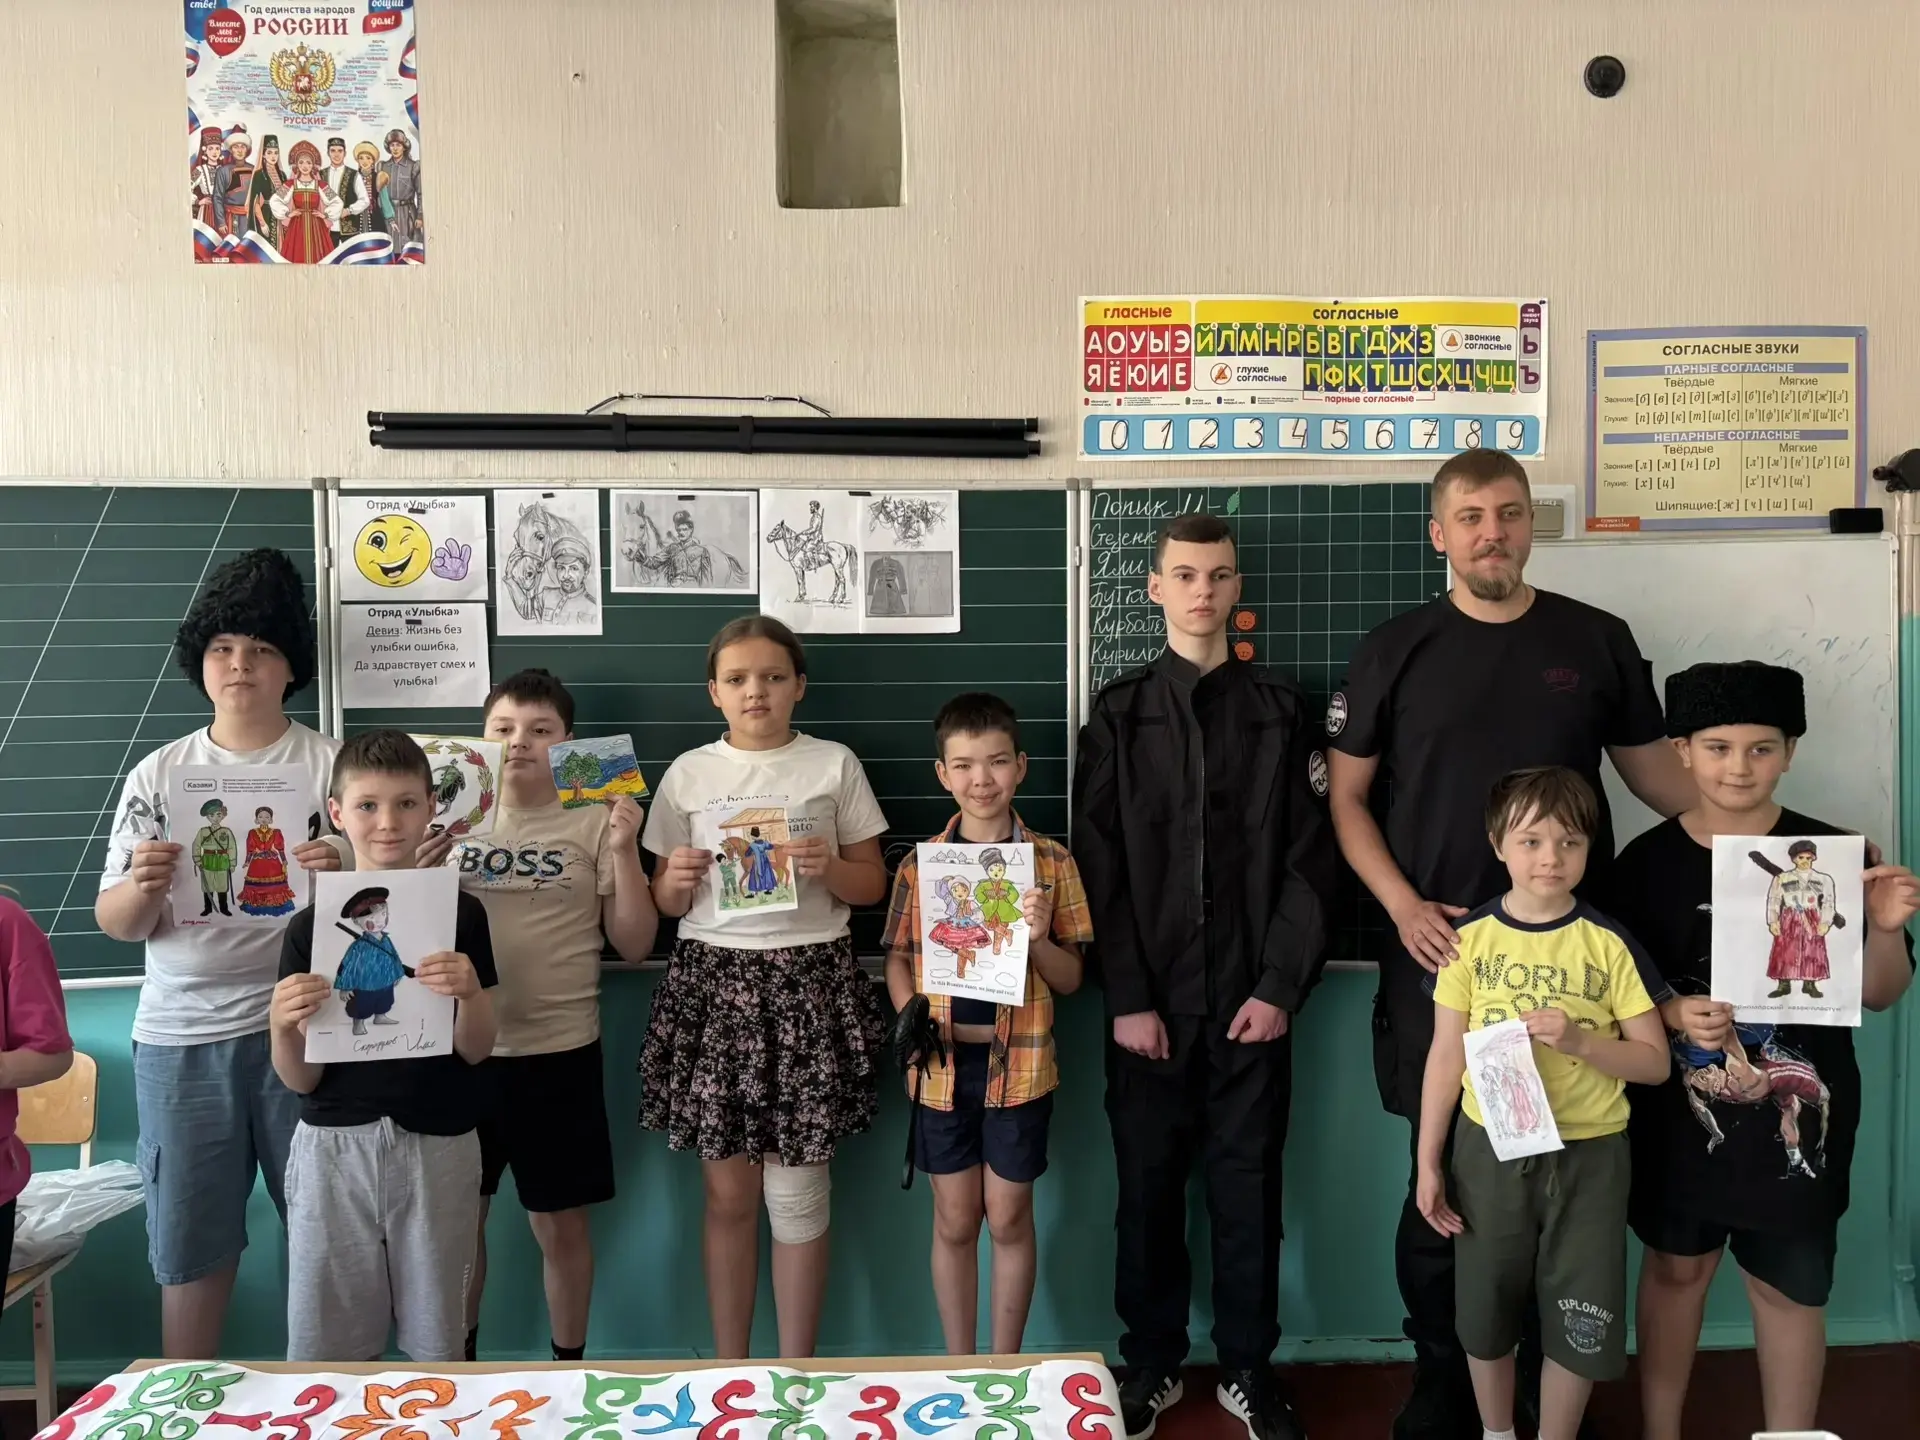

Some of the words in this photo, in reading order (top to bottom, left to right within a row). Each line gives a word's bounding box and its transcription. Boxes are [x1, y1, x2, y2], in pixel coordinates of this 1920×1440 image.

[244, 5, 262, 14] Год
[266, 6, 311, 14] единства
[314, 7, 355, 15] народов
[252, 18, 348, 35] РОССИИ
[370, 16, 395, 28] дом!
[208, 34, 242, 43] Россия!
[284, 116, 326, 125] РУССКИЕ
[1104, 306, 1172, 318] гласные
[1313, 306, 1399, 320] согласные
[1464, 334, 1500, 342] звонкие
[1464, 342, 1512, 351] согласные
[1663, 344, 1752, 356] СОГЛАСНЫЕ
[1755, 344, 1799, 354] ЗВУКИ
[1236, 365, 1269, 375] глухие
[1664, 364, 1718, 375] ПАРНЫЕ
[1721, 364, 1794, 373] СОГЛАСНЫЕ
[1236, 374, 1287, 383] согласные
[1664, 378, 1715, 388] Твёрдые
[1779, 376, 1818, 386] Мягкие
[1324, 395, 1361, 405] парные
[1363, 394, 1414, 403] согласные
[1111, 420, 1129, 450] 0
[1161, 420, 1173, 450] 1
[1199, 418, 1218, 449] 2
[1247, 418, 1264, 448] 3
[1292, 418, 1307, 448] 4
[1331, 419, 1348, 449] 5
[1376, 419, 1395, 449] 6
[1422, 418, 1439, 449] 7
[1465, 420, 1482, 448] 8
[1507, 421, 1524, 449] 9
[1654, 432, 1724, 442] НЕПАРНЫЕ
[1728, 431, 1800, 440] СОГЛАСНЫЕ
[1663, 444, 1714, 455] Твёрдые
[1779, 443, 1818, 453] Мягкие
[366, 500, 400, 511] Отряд
[404, 499, 456, 509] «Улыбка»
[1655, 500, 1717, 511] Шипящие:
[368, 608, 402, 619] Отряд
[405, 607, 459, 617] «Улыбка»
[366, 626, 403, 637] Девиз:
[406, 626, 442, 634] Жизнь
[444, 624, 462, 634] без
[370, 642, 411, 653] улыбки
[414, 642, 459, 652] ошибка,
[354, 661, 369, 672] Да
[372, 661, 437, 672] здравствует
[393, 676, 438, 688] улыбка!
[458, 848, 564, 877] BOSS
[1472, 954, 1610, 1002] WORLD
[1558, 1299, 1614, 1323] EXPLORING
